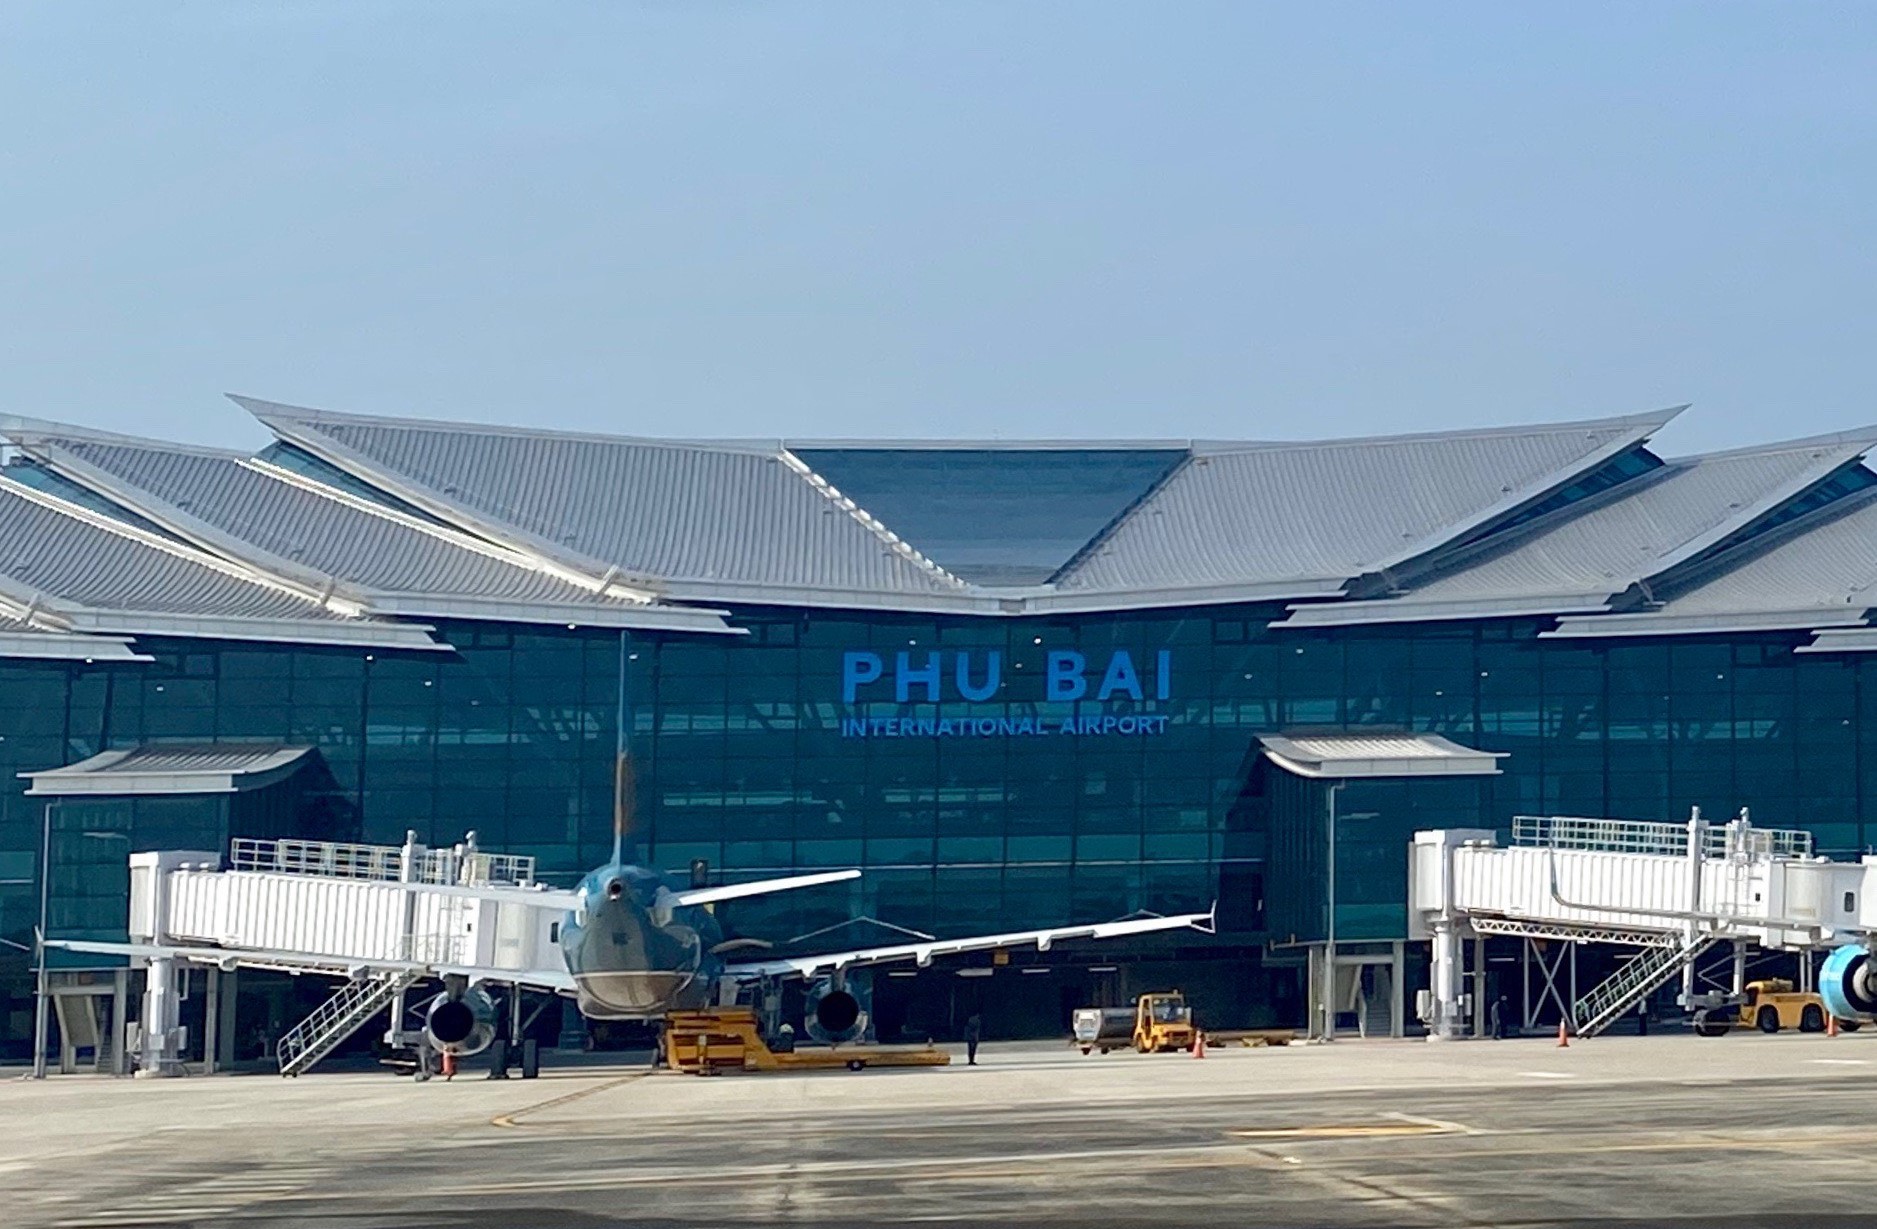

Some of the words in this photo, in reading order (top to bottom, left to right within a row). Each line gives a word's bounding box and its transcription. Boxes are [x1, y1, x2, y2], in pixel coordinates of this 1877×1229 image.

[843, 651, 1000, 702] PHU
[1047, 650, 1171, 701] BAI
[842, 717, 1049, 737] INTERNATIONAL
[1059, 715, 1168, 735] AIRPORT
